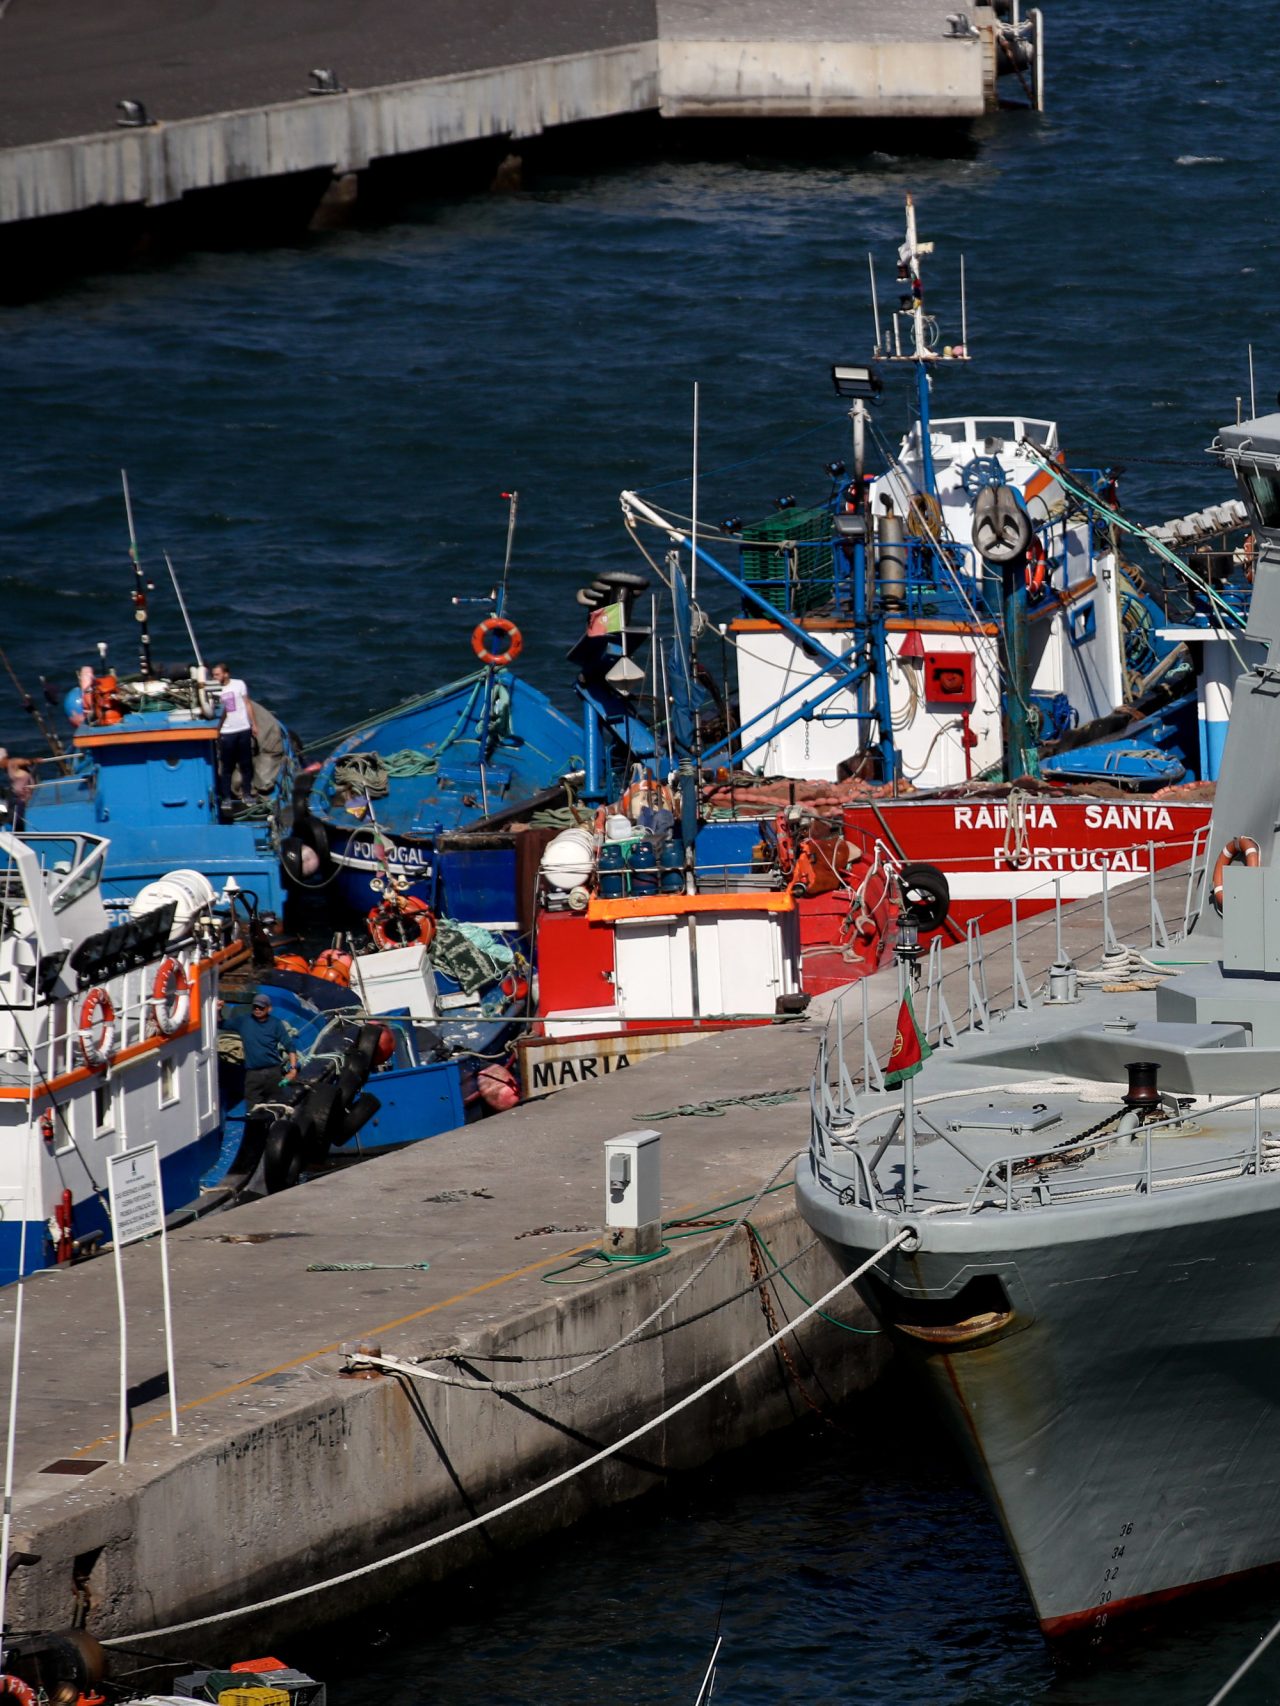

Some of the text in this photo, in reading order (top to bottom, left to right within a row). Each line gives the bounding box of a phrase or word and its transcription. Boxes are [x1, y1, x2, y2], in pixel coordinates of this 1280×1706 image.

[954, 805, 1174, 830] RAINHA SANTA
[353, 841, 428, 865] POUGAL
[994, 847, 1148, 871] PORTUGAL
[533, 1054, 630, 1088] MARIA
[1120, 1522, 1134, 1537] 36
[1112, 1545, 1125, 1559] 34
[1104, 1566, 1119, 1581] 32
